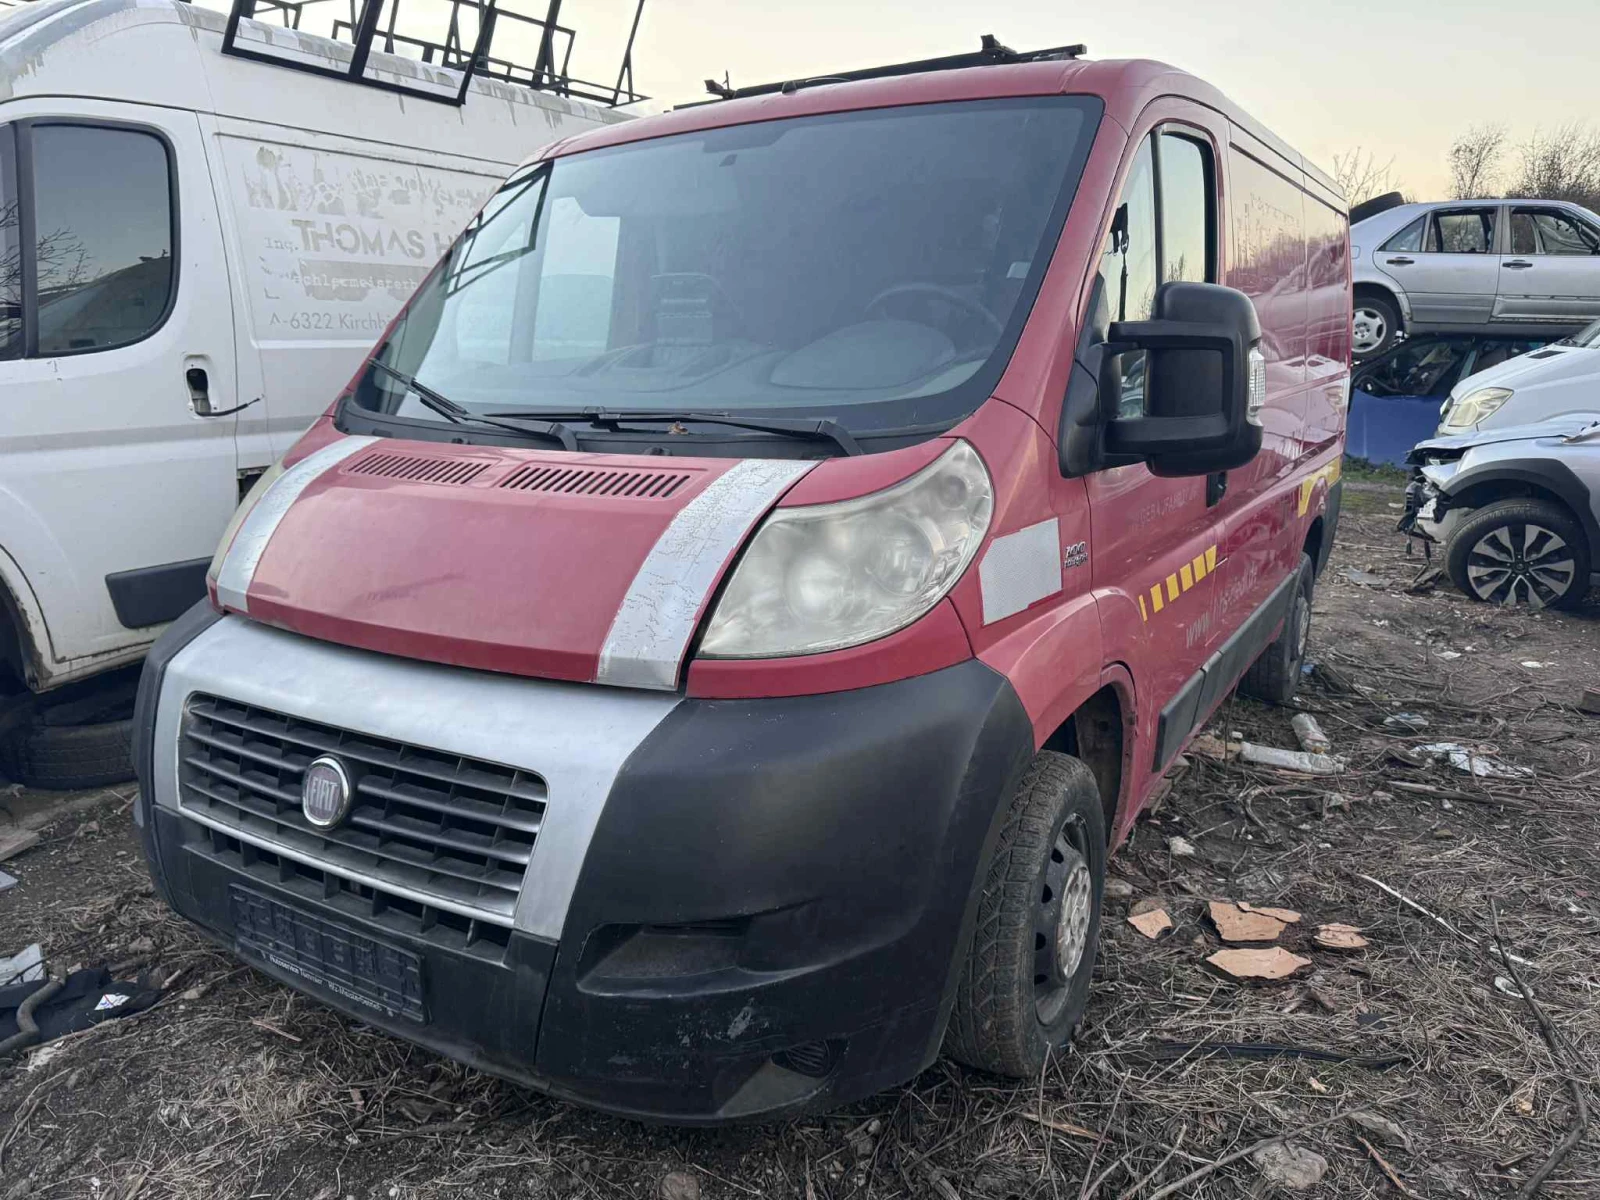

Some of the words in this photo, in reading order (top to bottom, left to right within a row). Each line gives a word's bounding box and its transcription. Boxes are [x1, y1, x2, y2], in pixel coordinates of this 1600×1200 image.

[291, 218, 426, 260] THOMAS
[269, 312, 333, 330] A-6322
[309, 776, 338, 812] FIAT
